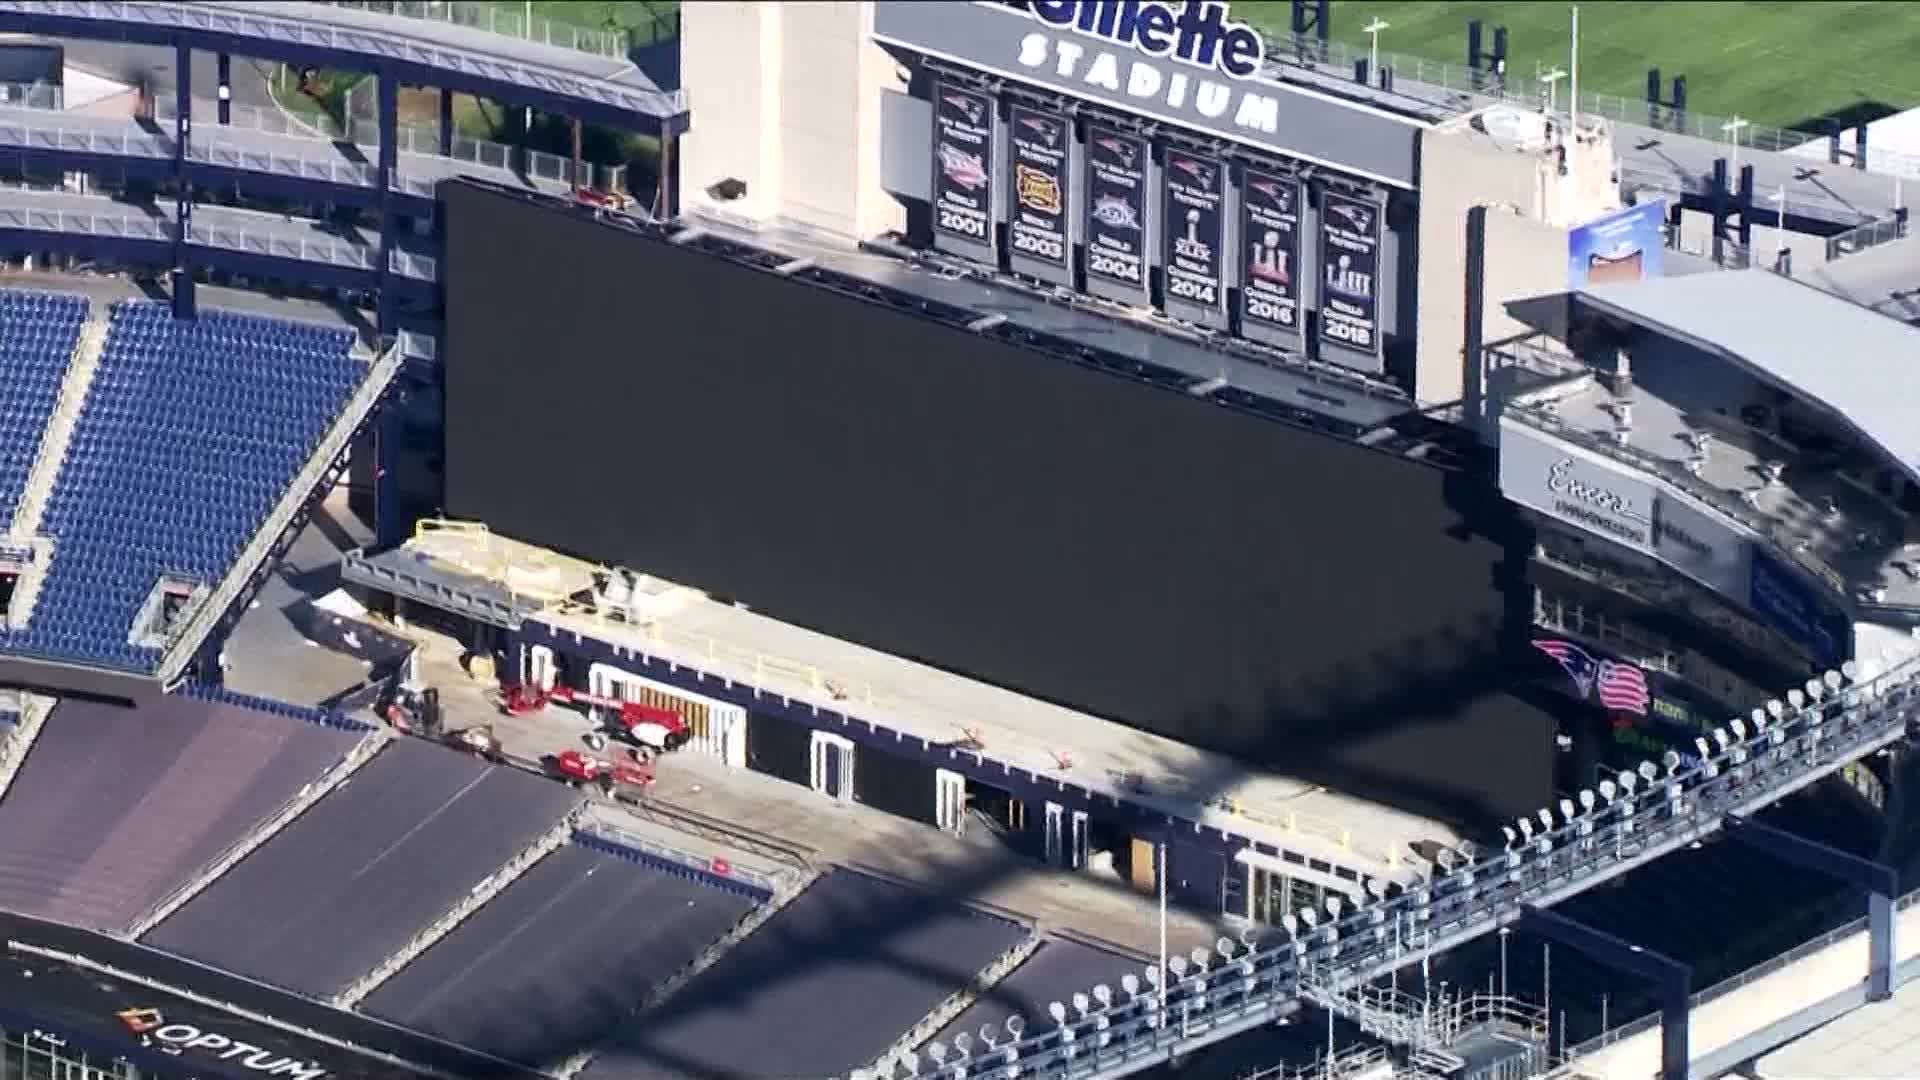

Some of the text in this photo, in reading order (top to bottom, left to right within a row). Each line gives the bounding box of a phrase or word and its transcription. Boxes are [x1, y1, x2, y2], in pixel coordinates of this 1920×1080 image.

[1018, 33, 1279, 133] STADIUM
[941, 212, 985, 237] 2001
[1014, 231, 1063, 258] 2003
[1090, 255, 1140, 280] 2004
[1170, 278, 1215, 303] 2014
[1248, 299, 1293, 324] 2016
[1325, 319, 1371, 345] 2018
[155, 1024, 326, 1080] OPTUM
